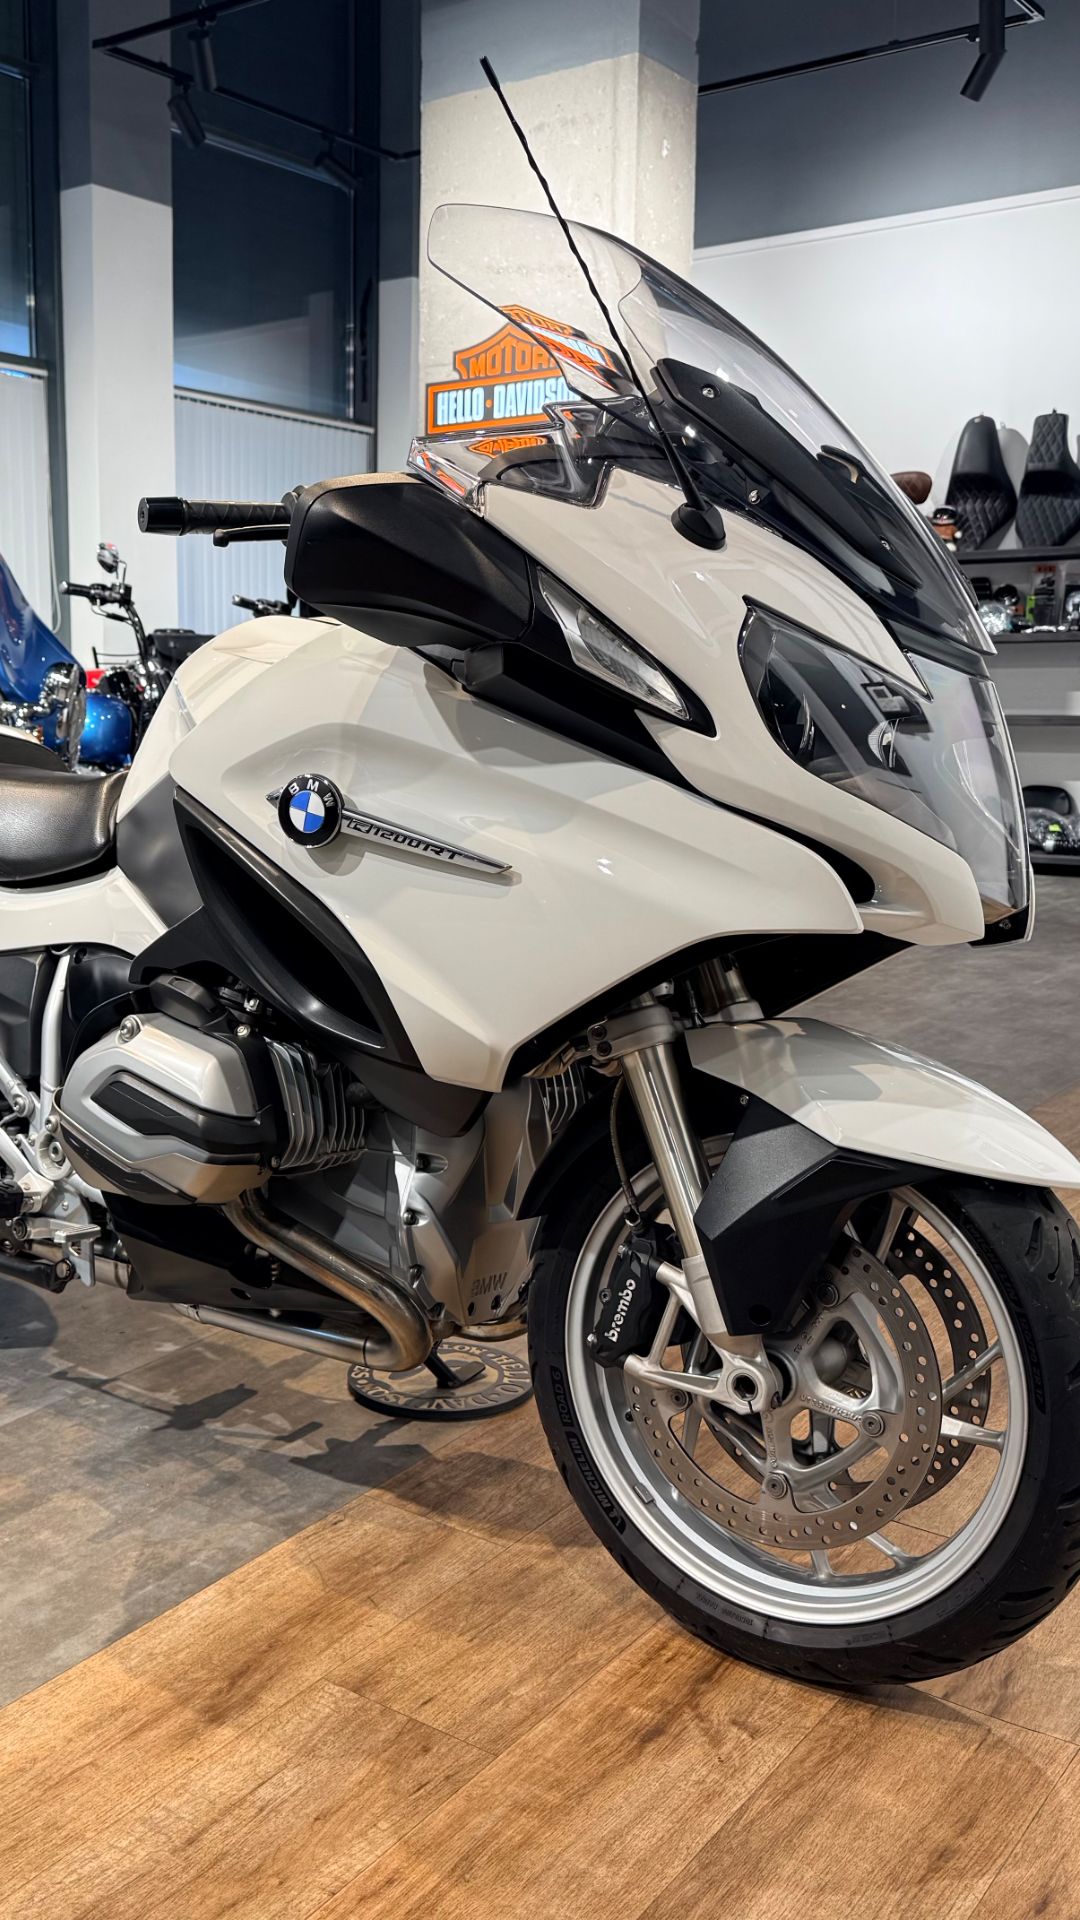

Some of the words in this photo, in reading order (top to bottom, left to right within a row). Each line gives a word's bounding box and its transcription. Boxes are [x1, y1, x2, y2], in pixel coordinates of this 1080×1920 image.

[437, 387, 485, 426] HELLO
[493, 376, 579, 419] DAVIDSO
[288, 779, 336, 808] BMW
[472, 1272, 508, 1297] BMW
[604, 1278, 637, 1343] brembo
[555, 1384, 573, 1424] ROAD
[568, 1437, 612, 1509] MICHELIN
